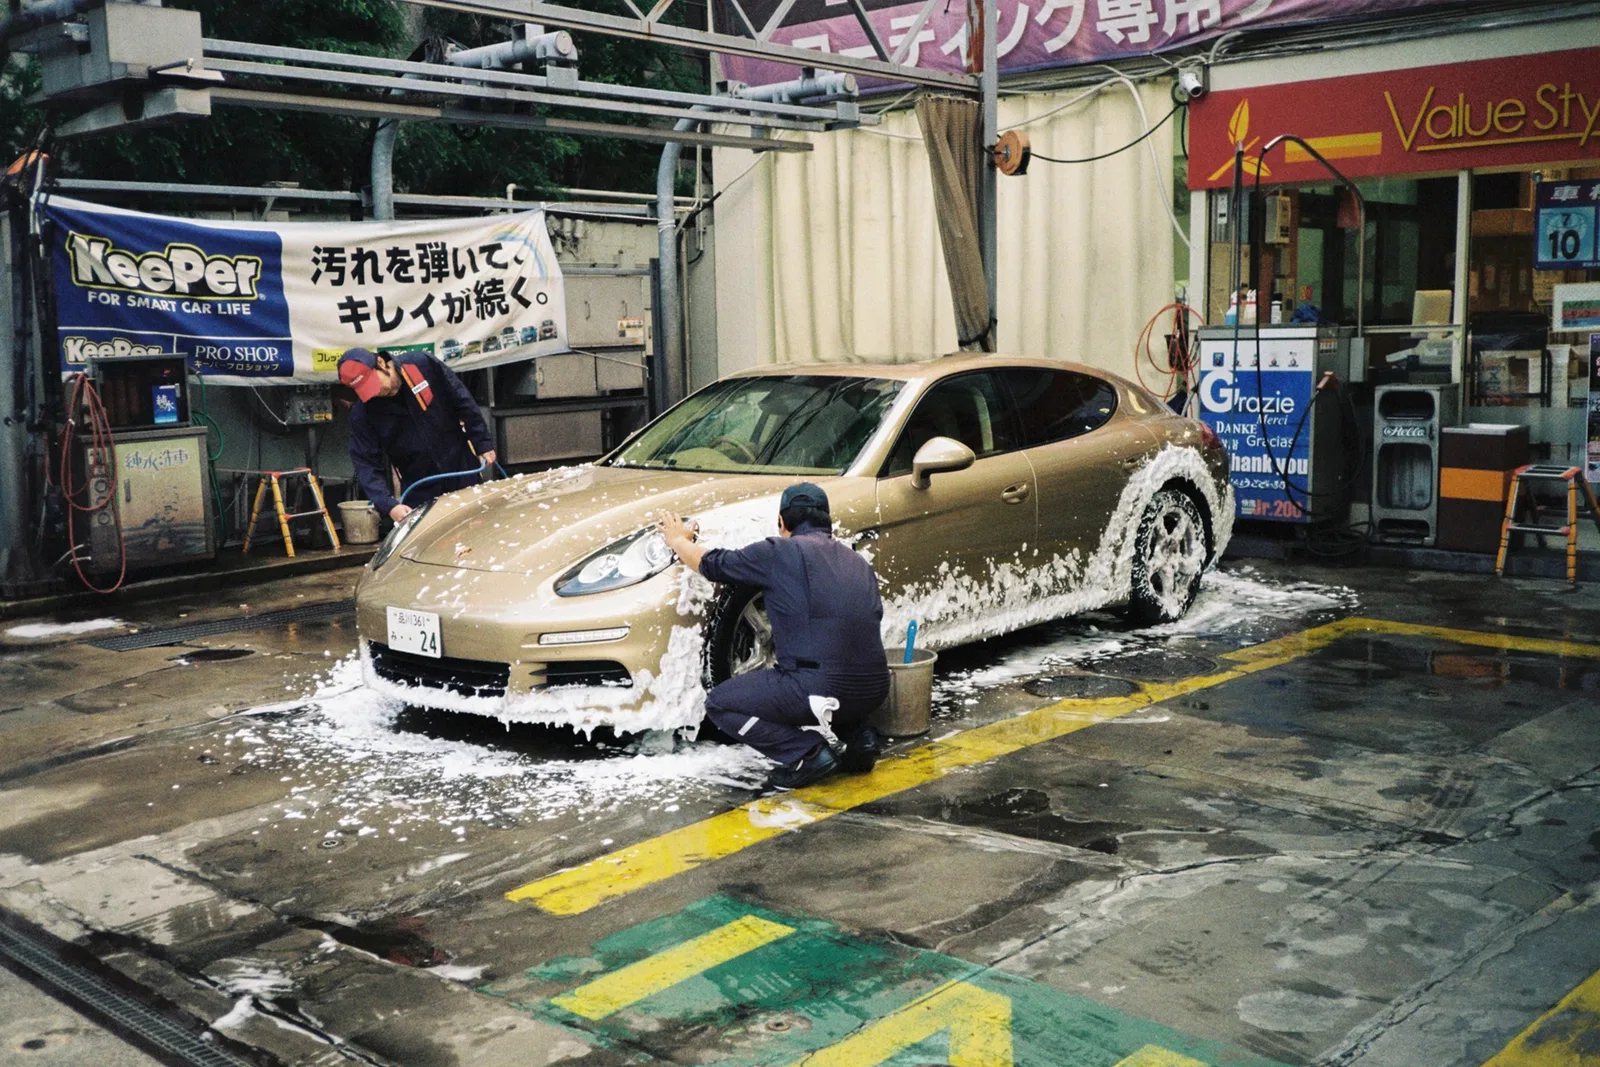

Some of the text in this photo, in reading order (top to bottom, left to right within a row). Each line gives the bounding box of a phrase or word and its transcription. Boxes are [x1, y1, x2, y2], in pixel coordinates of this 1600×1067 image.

[792, 0, 1268, 67] コーティング専用
[1384, 87, 1525, 151] Value
[1561, 212, 1571, 227] 7
[1549, 229, 1580, 260] 10
[67, 231, 261, 299] KeePer
[311, 241, 525, 287] 汚れを弾いて、
[88, 291, 251, 315] FOR SMART CAR LIFE
[337, 276, 548, 334] キレイが続く。
[194, 345, 279, 362] PRO SHOP
[1200, 369, 1295, 413] Grazie
[1216, 420, 1257, 434] DANKE
[1256, 413, 1288, 426] Merci
[1246, 434, 1294, 448] Gracias
[1228, 453, 1308, 475] hank you
[419, 630, 437, 654] 24
